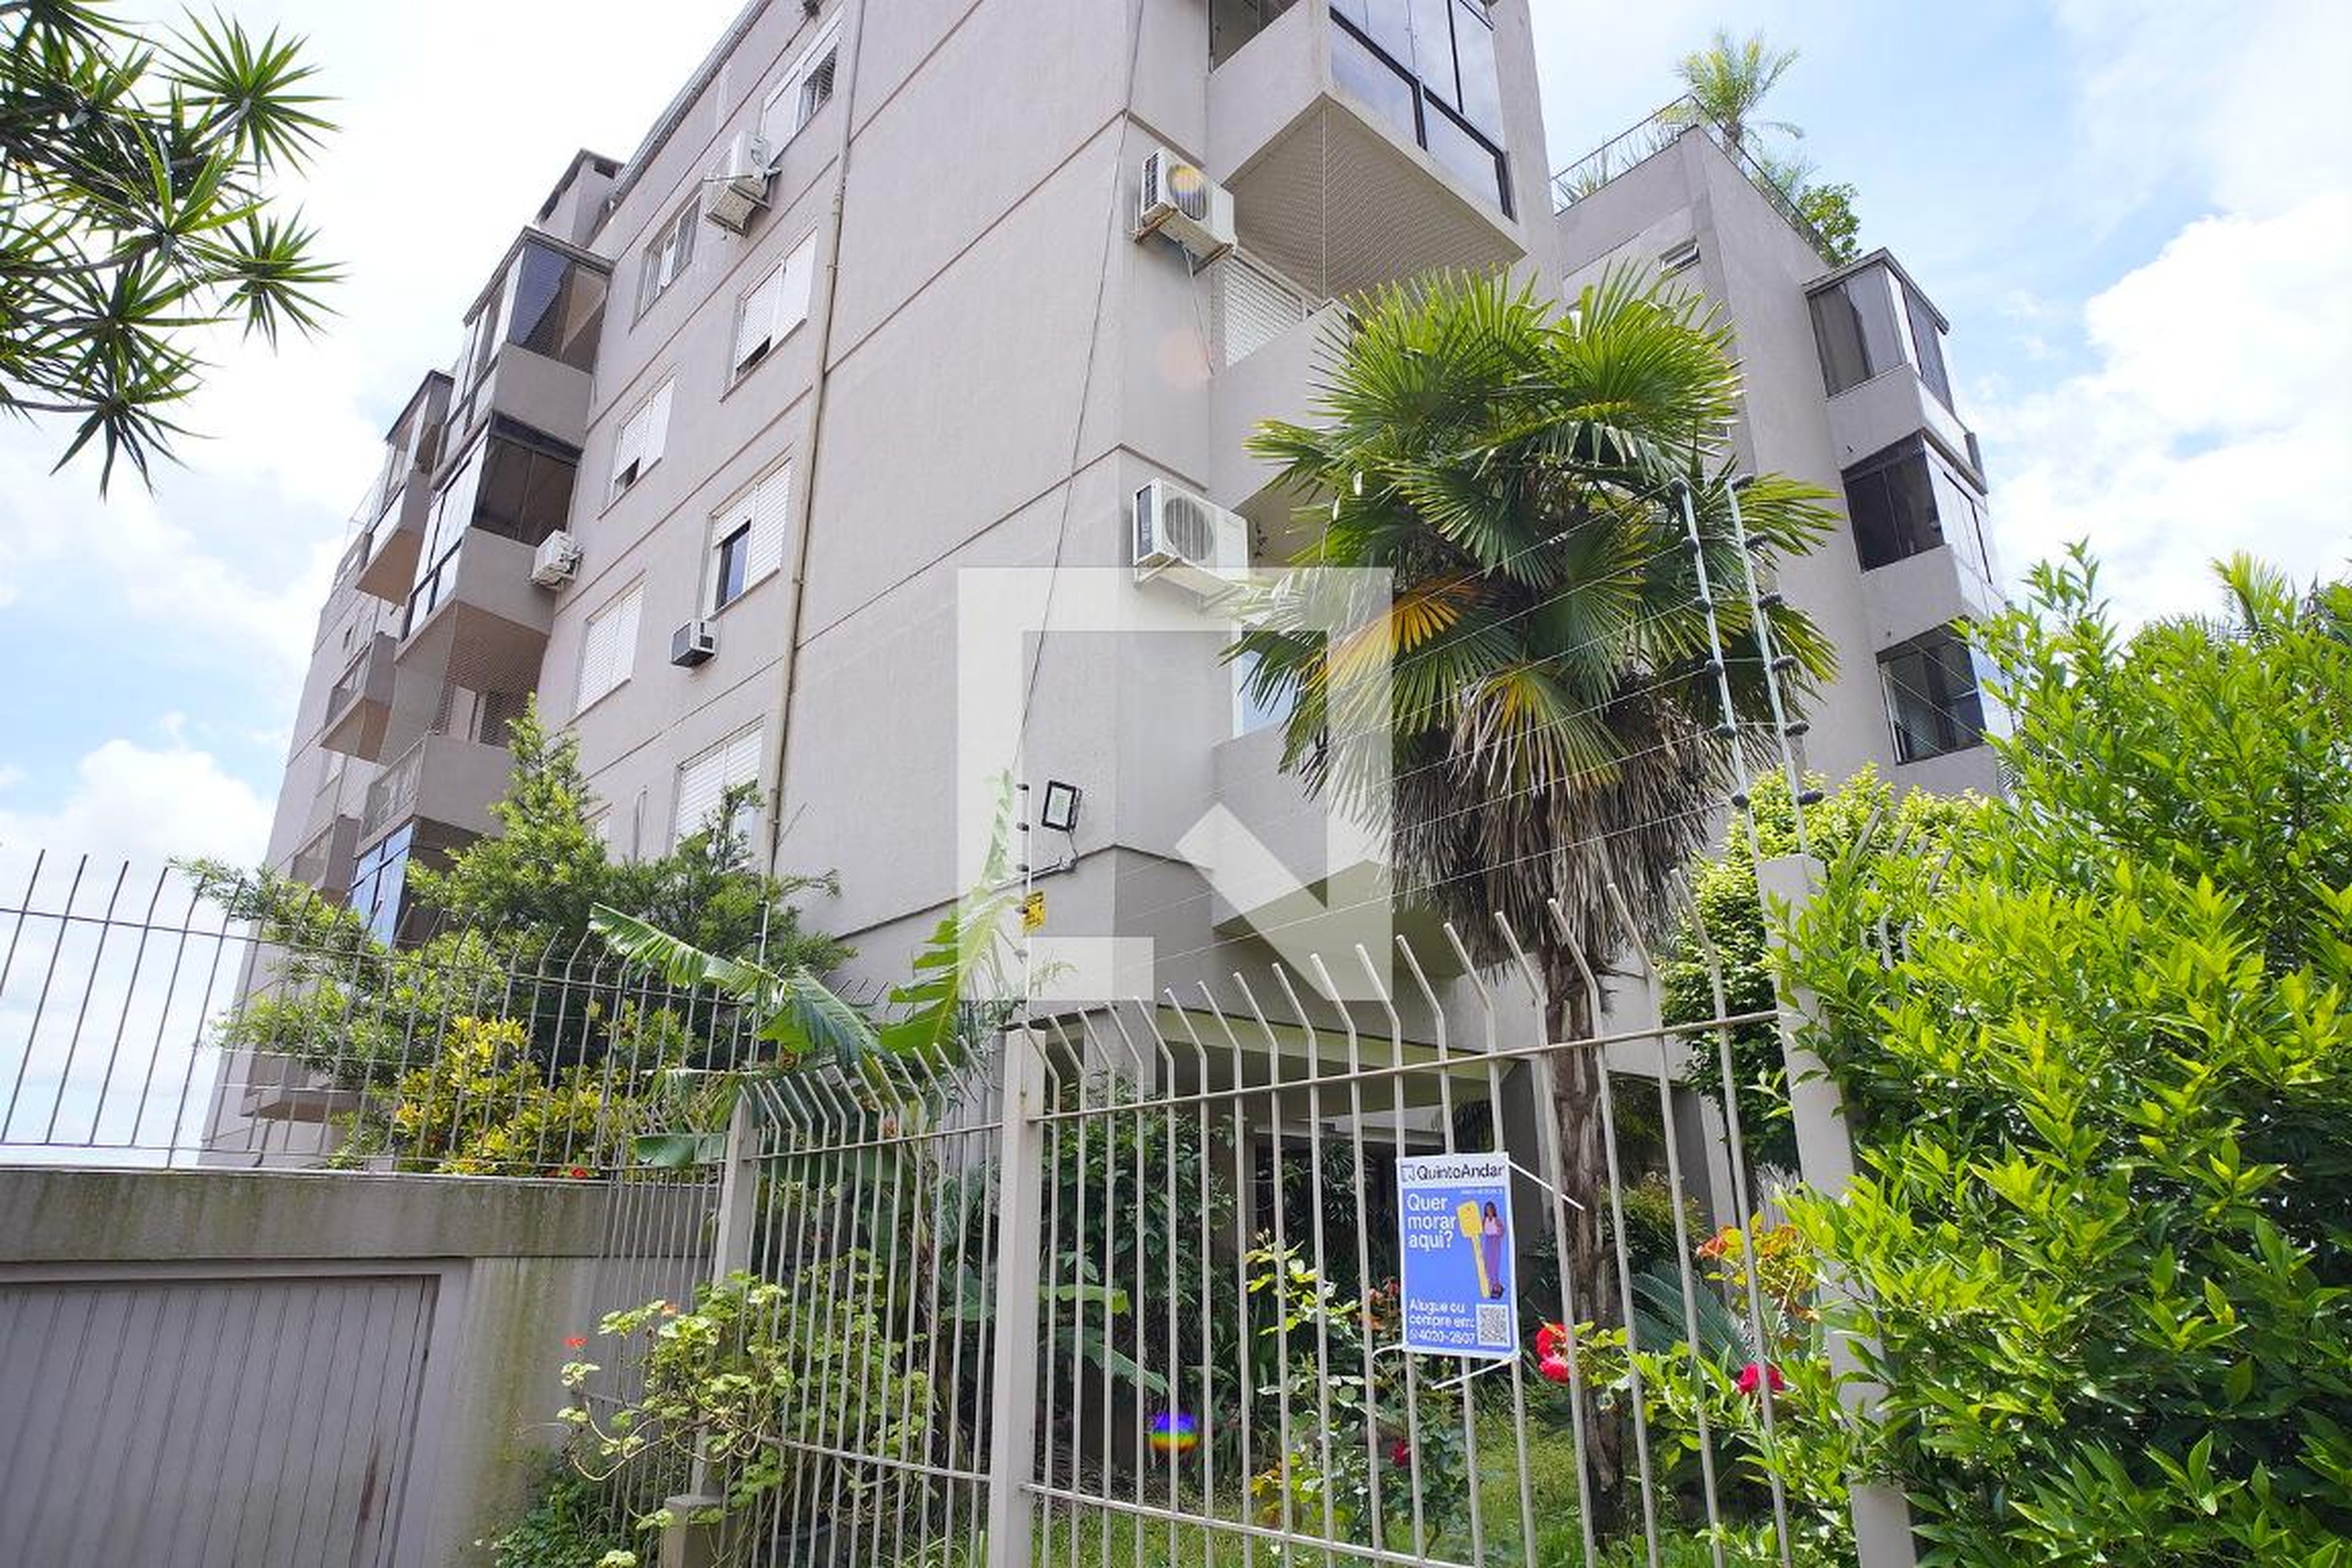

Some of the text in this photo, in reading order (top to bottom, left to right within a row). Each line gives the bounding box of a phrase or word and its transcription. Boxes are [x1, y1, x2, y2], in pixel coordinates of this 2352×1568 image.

[1416, 1163, 1504, 1180] QuintoAndar
[1407, 1194, 1447, 1211] Quer
[1409, 1216, 1456, 1229] morar
[1409, 1231, 1453, 1251] aqui?
[1410, 1298, 1465, 1314] Alugue ou
[1409, 1314, 1452, 1328] compre
